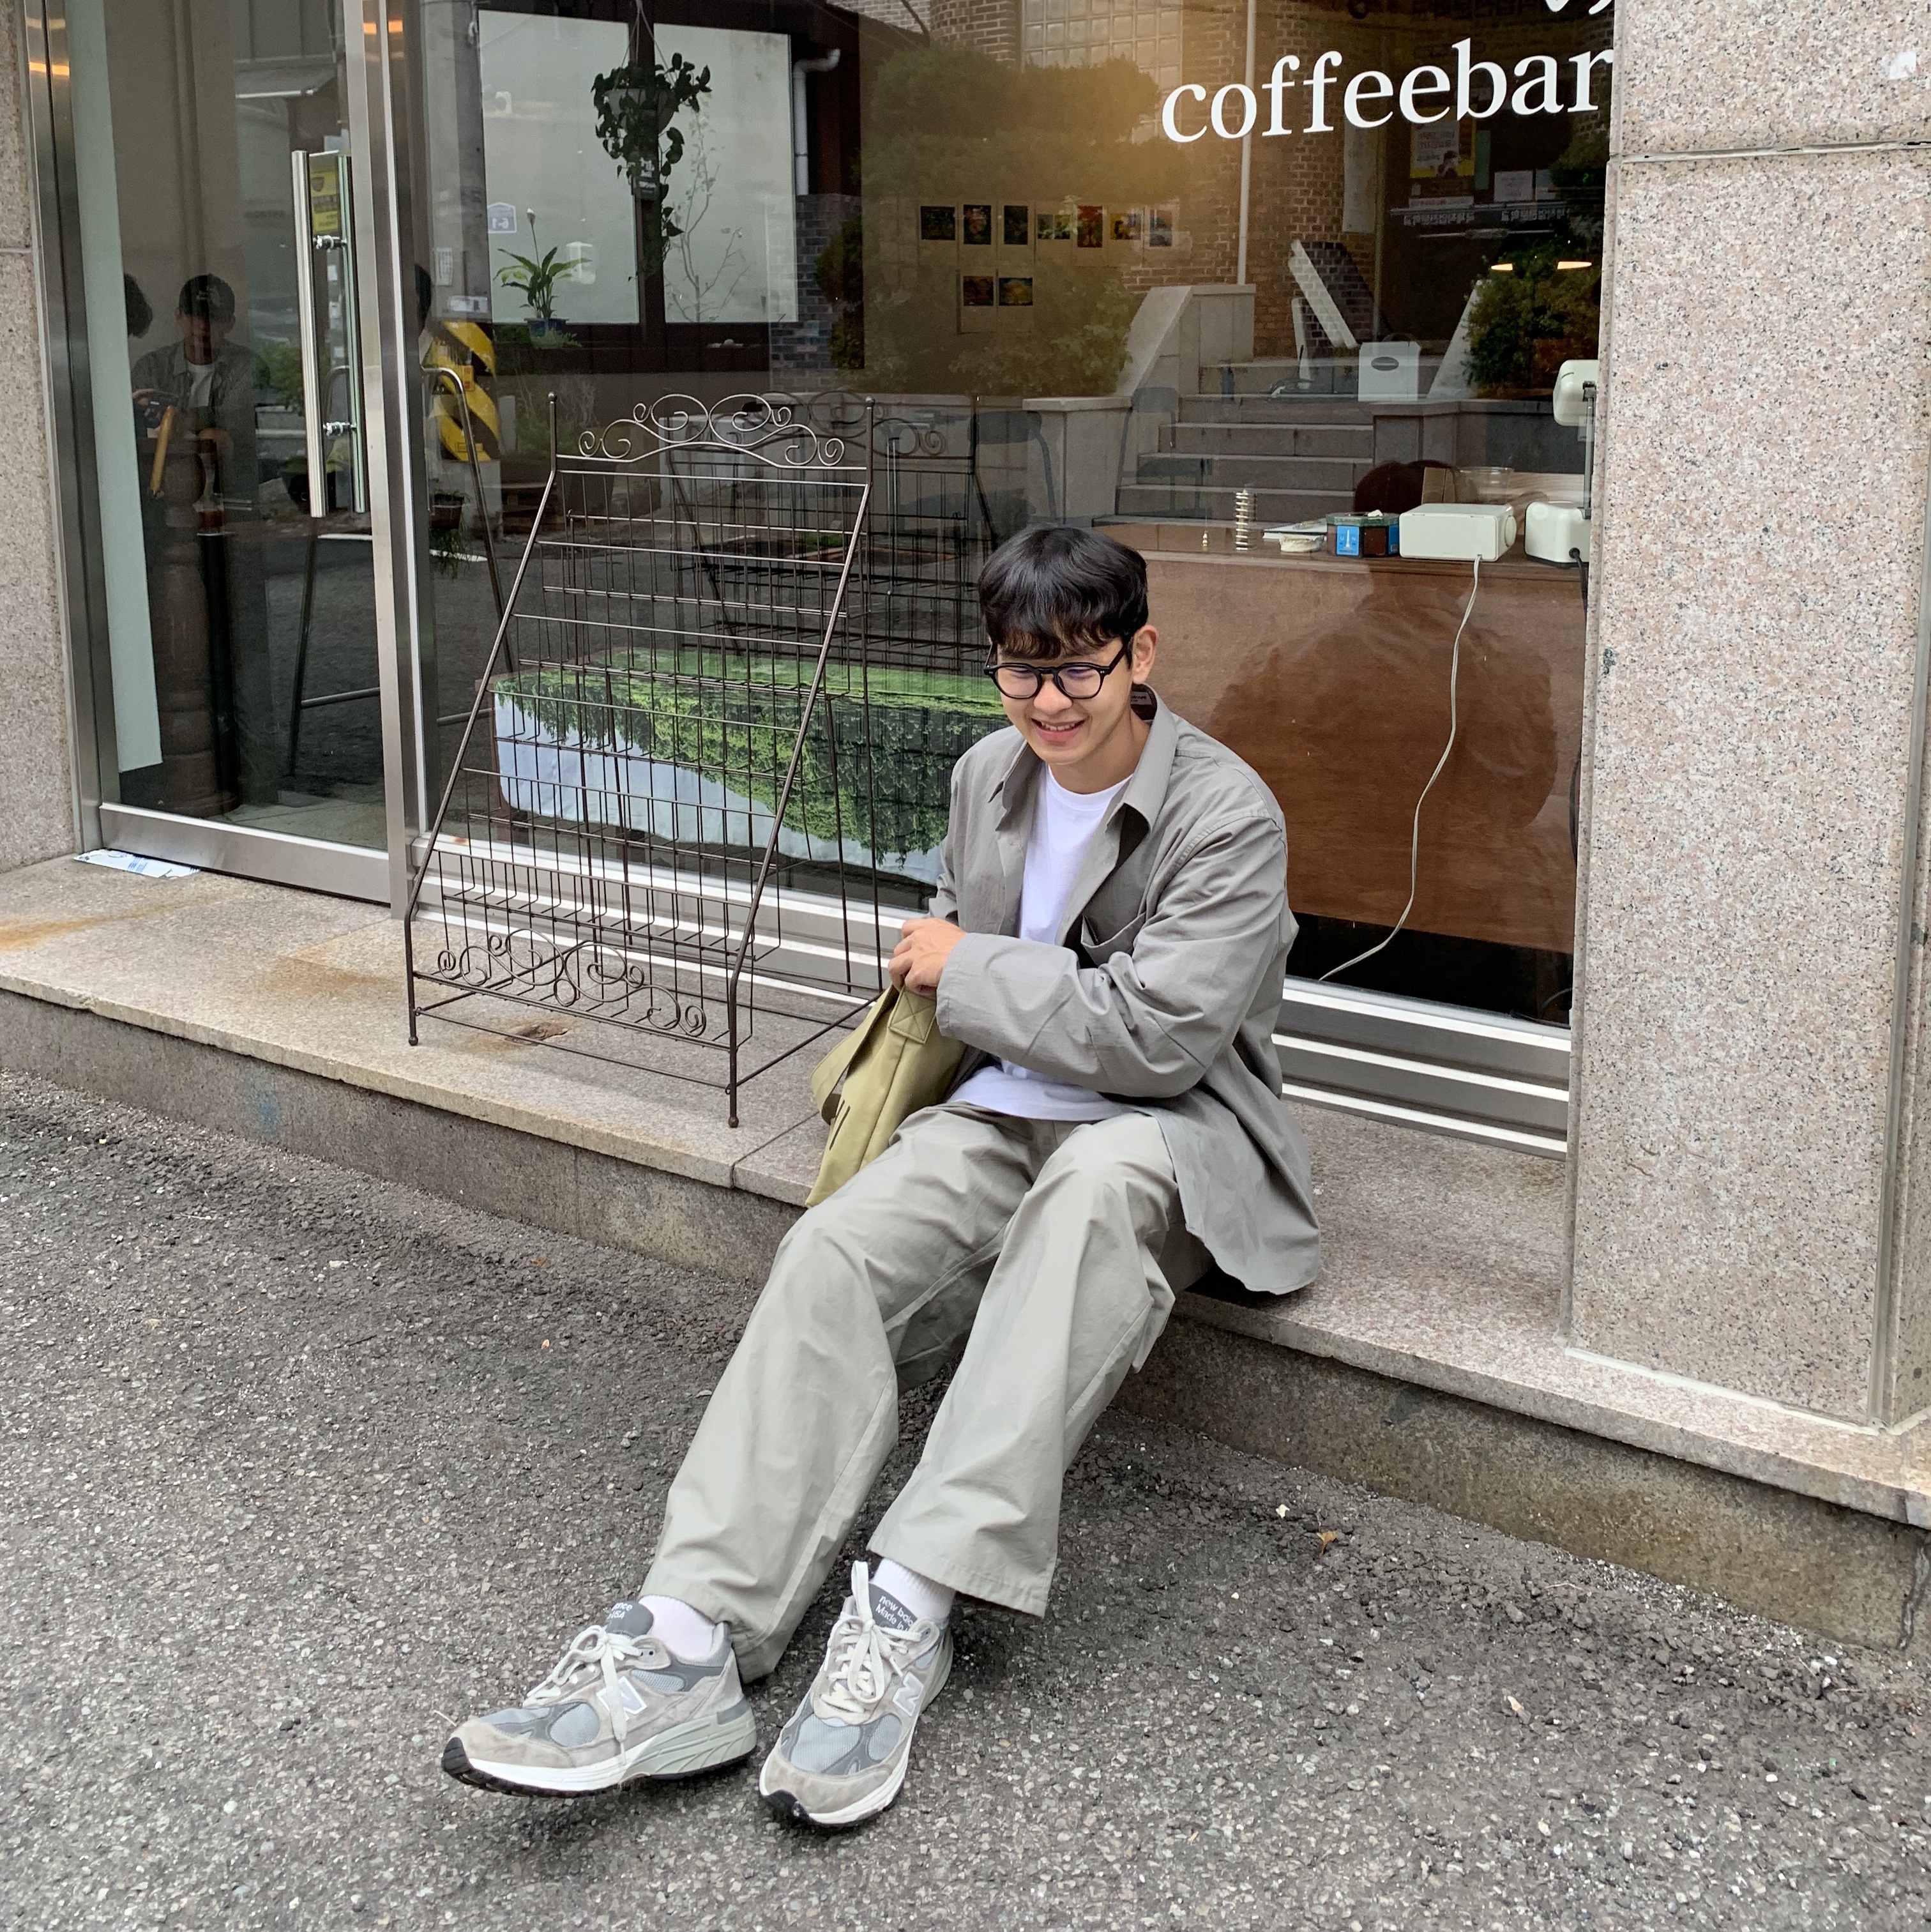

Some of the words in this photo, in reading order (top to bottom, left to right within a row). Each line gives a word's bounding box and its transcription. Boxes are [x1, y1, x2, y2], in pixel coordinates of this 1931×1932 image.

[1162, 38, 1614, 143] coffeebar
[875, 1603, 897, 1625] Made
[879, 1595, 898, 1611] new
[897, 1607, 914, 1627] bala
